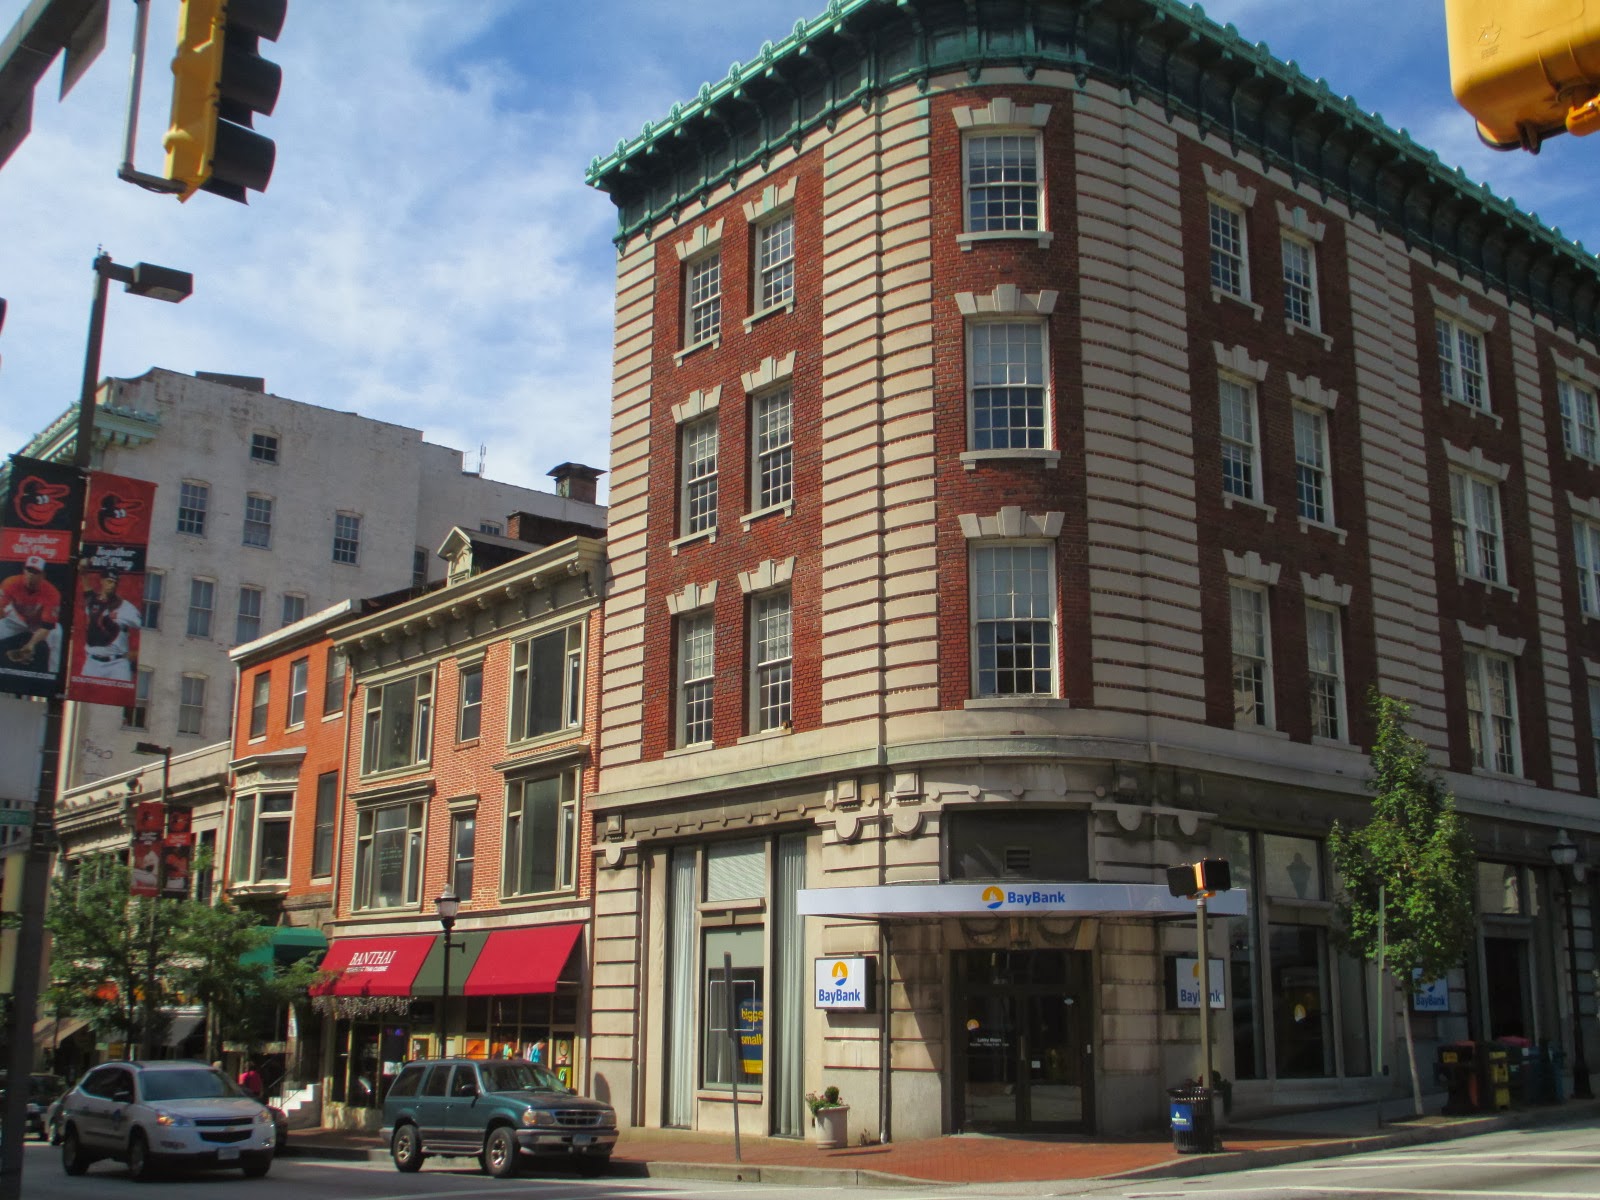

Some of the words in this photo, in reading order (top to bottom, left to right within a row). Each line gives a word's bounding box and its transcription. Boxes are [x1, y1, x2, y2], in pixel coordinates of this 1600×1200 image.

[18, 533, 60, 545] Together
[32, 545, 57, 558] Play
[96, 546, 136, 557] Together
[91, 556, 109, 567] We
[109, 557, 133, 571] Play
[1008, 891, 1066, 907] BayBank
[818, 989, 861, 1005] BayBank
[1180, 989, 1221, 1005] Baynk
